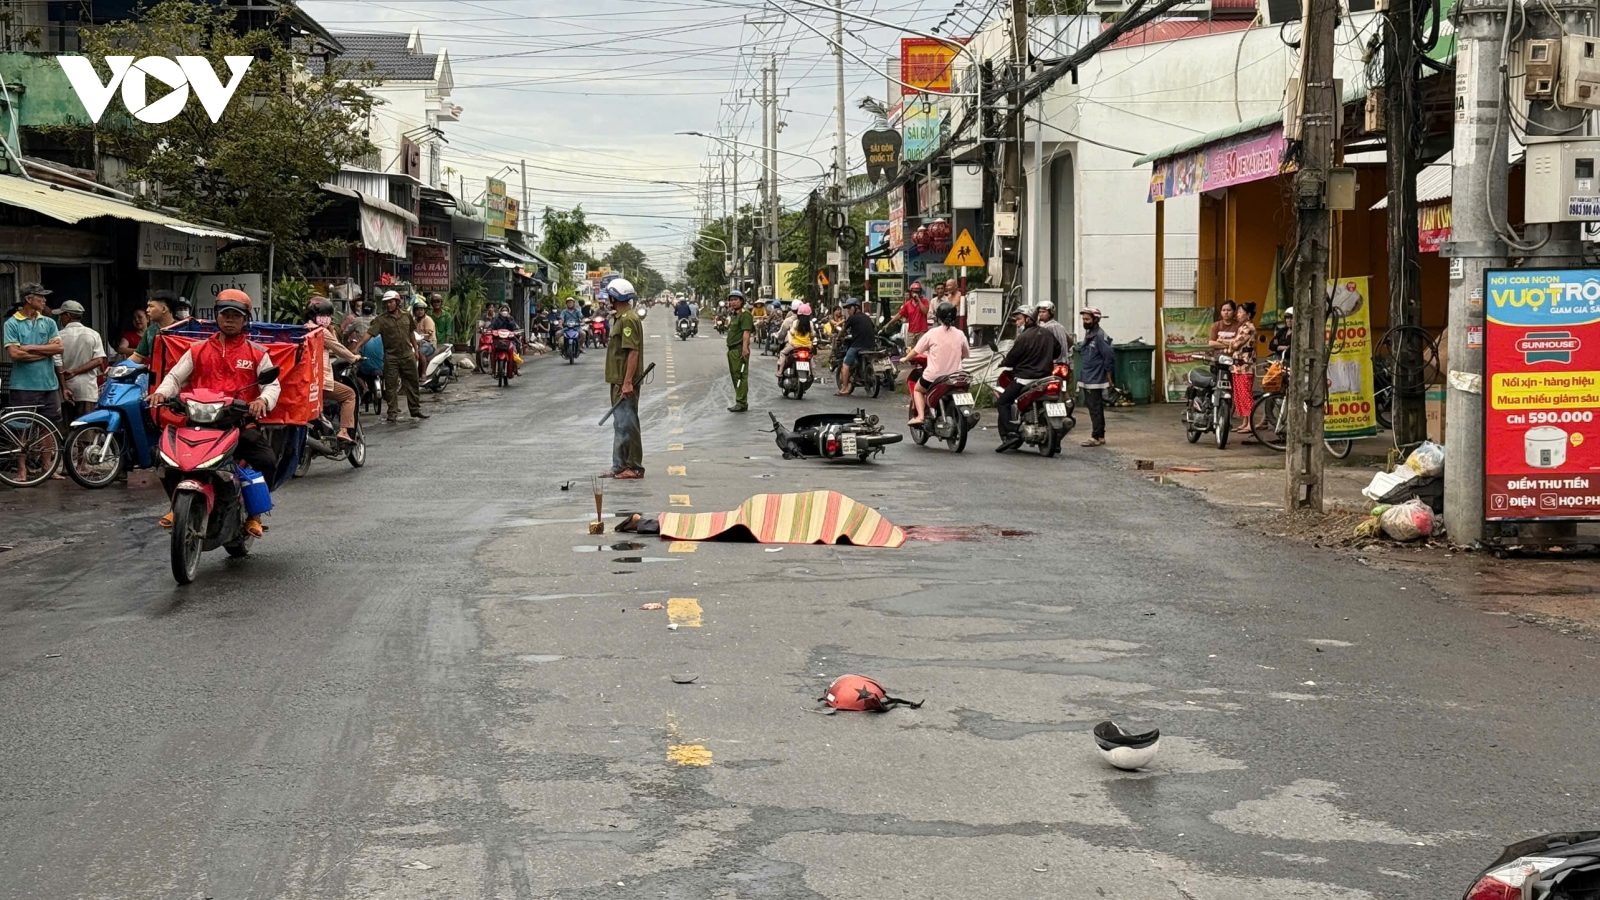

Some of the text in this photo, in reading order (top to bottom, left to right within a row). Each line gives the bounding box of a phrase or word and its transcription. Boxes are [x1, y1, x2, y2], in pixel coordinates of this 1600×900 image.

[910, 53, 948, 82] NHA
[907, 123, 935, 140] SÀI GN
[870, 142, 894, 152] SÀI GÒN
[869, 151, 895, 163] QUỐC TẾ
[1532, 275, 1560, 284] NGON
[1573, 304, 1588, 314] GIÁ
[1521, 340, 1575, 350] SUNHOUSE
[236, 359, 254, 369] SPX
[1543, 375, 1571, 388] hàng
[1571, 374, 1595, 386] hiệu
[1497, 395, 1521, 405] Mua
[1580, 393, 1600, 404] sâu
[1529, 411, 1593, 424] 590.000
[1507, 476, 1538, 490] ĐIỂM
[1538, 478, 1562, 490] THU
[1509, 495, 1536, 509] ĐIỆN
[1558, 495, 1584, 508] HỌC
